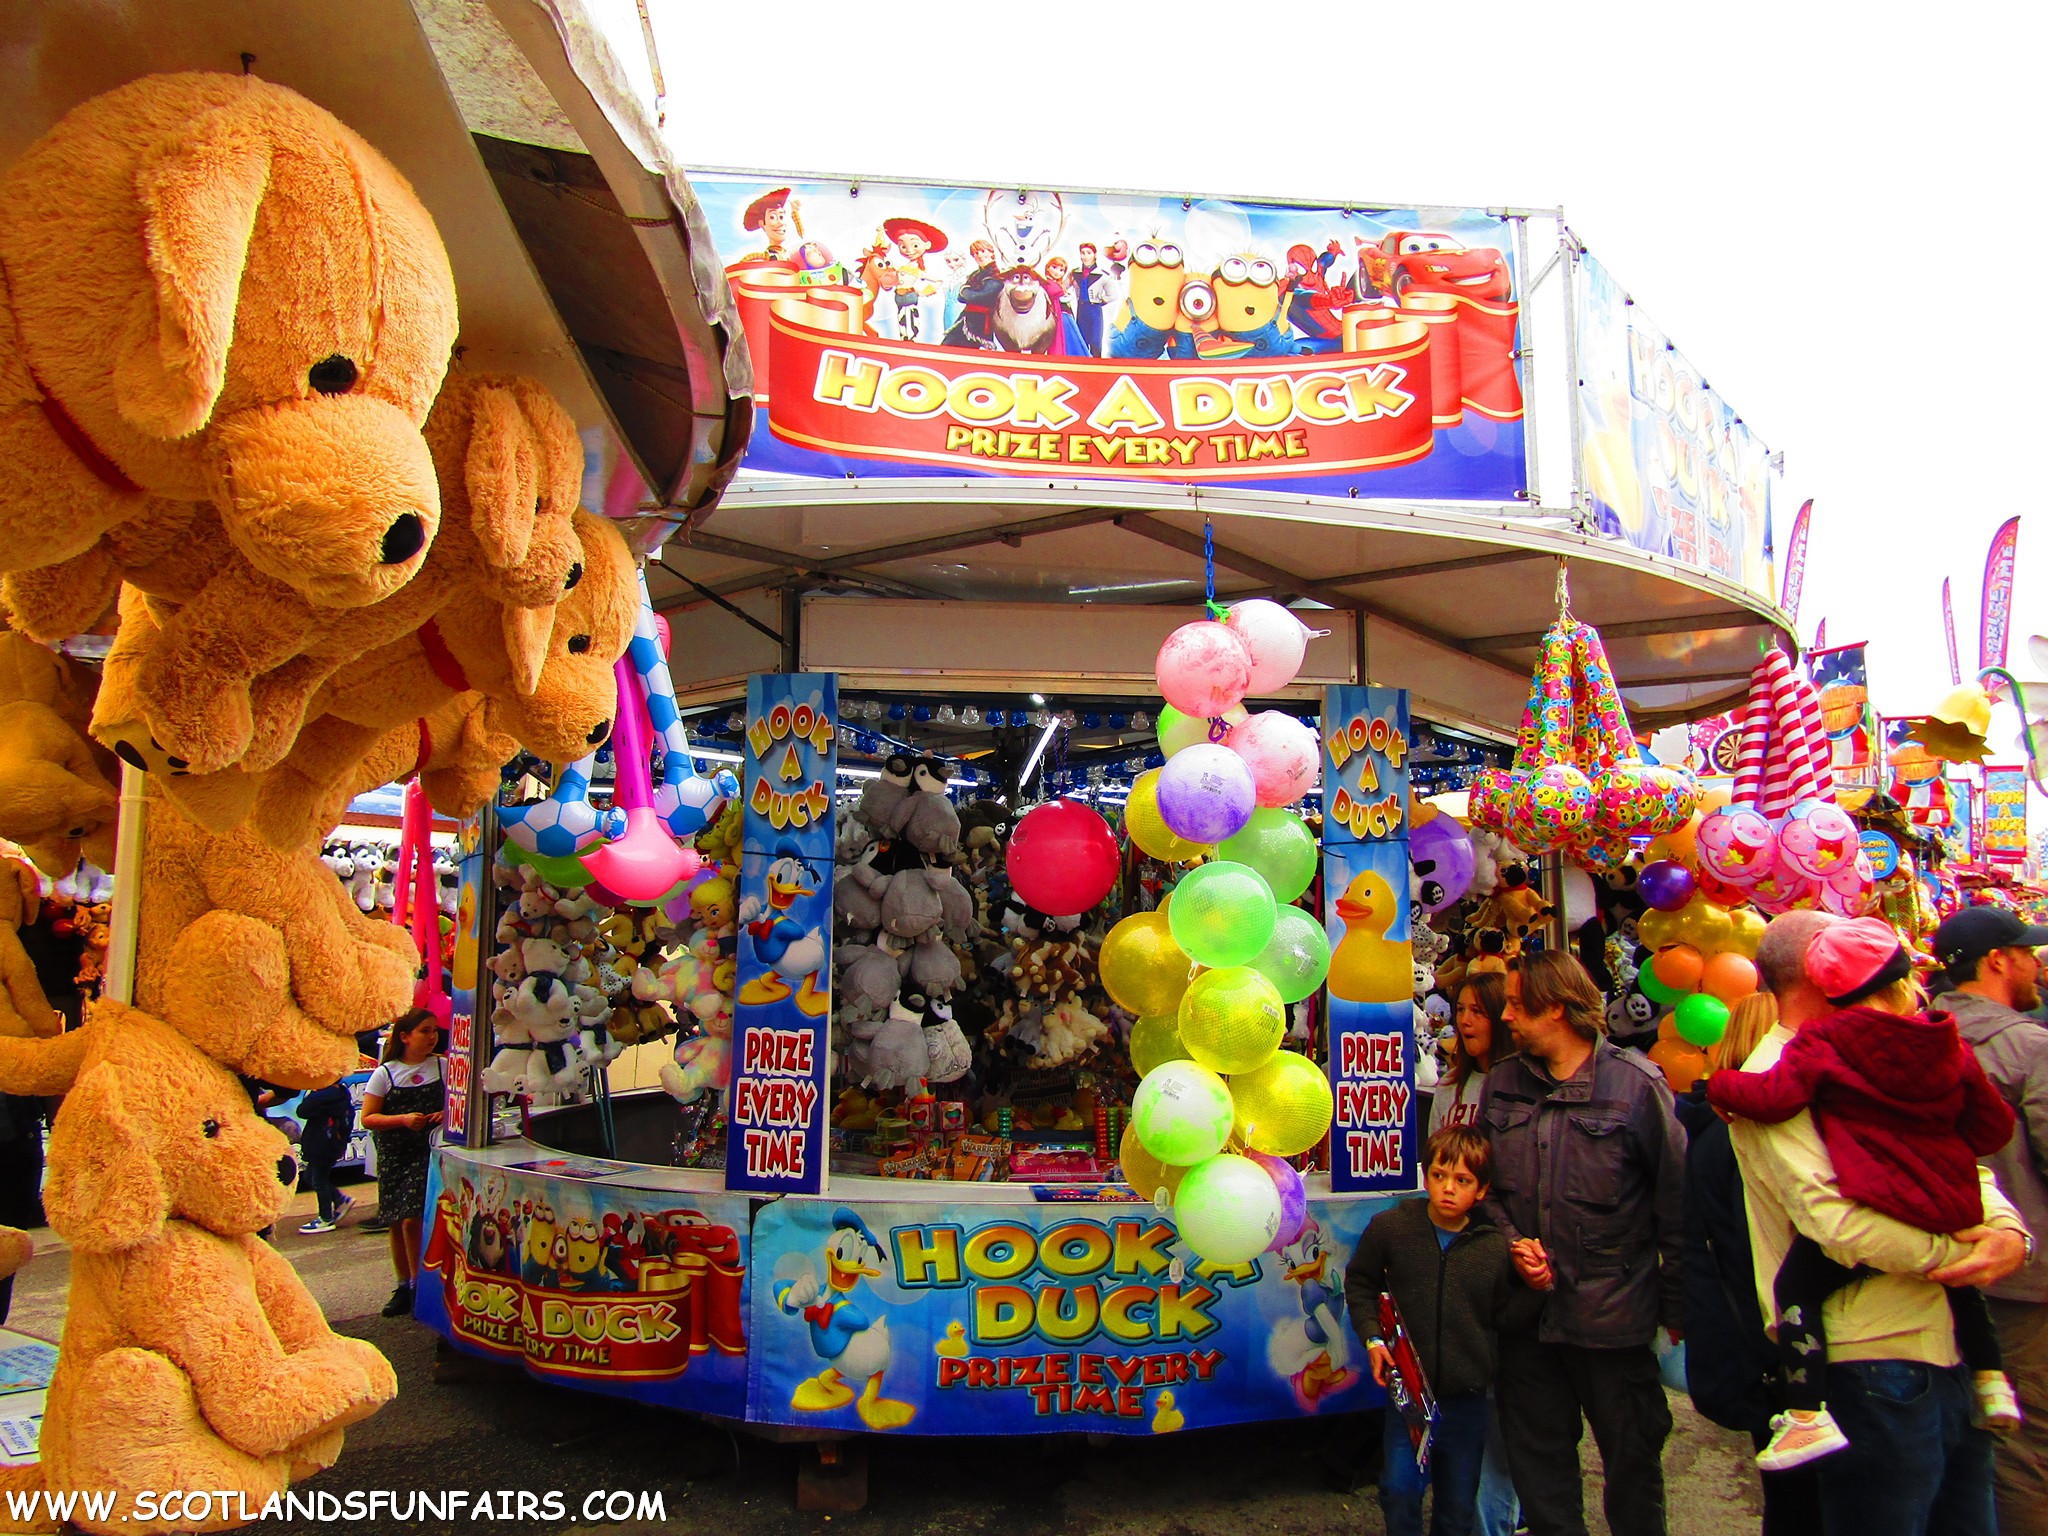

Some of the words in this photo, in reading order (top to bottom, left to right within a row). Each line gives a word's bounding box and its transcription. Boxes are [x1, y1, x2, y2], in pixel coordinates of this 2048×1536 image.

[813, 351, 1083, 427] HOOK
[1087, 374, 1165, 434] A
[1173, 363, 1419, 430] DUCK
[945, 424, 1061, 462] PRIZE
[1067, 432, 1202, 466] EVERY
[1213, 428, 1309, 460] TIME
[748, 703, 834, 760] HOOK
[1327, 716, 1407, 770] HOOK
[779, 742, 802, 782] A
[1358, 754, 1379, 793] A
[750, 775, 829, 830] DUCK
[1330, 786, 1403, 840] DUCK
[1987, 790, 2024, 805] HOOK
[1999, 804, 2012, 818] A
[452, 1013, 471, 1052] PRIZE
[744, 1027, 814, 1077] PRIZE
[1341, 1032, 1404, 1079] PRIZE
[447, 1052, 471, 1094] EVERY
[448, 1093, 465, 1134] TIME
[735, 1077, 818, 1128] EVERY
[1336, 1080, 1410, 1129] EVERY
[744, 1129, 806, 1179] TIME
[1346, 1130, 1403, 1178] TIME
[895, 1221, 1178, 1285] HOOK
[542, 1299, 682, 1345] DUCK
[976, 1284, 1217, 1341] DUCK
[463, 1314, 508, 1341] PRIZE
[562, 1343, 610, 1364] TIME
[939, 1353, 1072, 1387] PRIZE
[1077, 1350, 1225, 1387] EVERY
[1030, 1384, 1145, 1417] TIME
